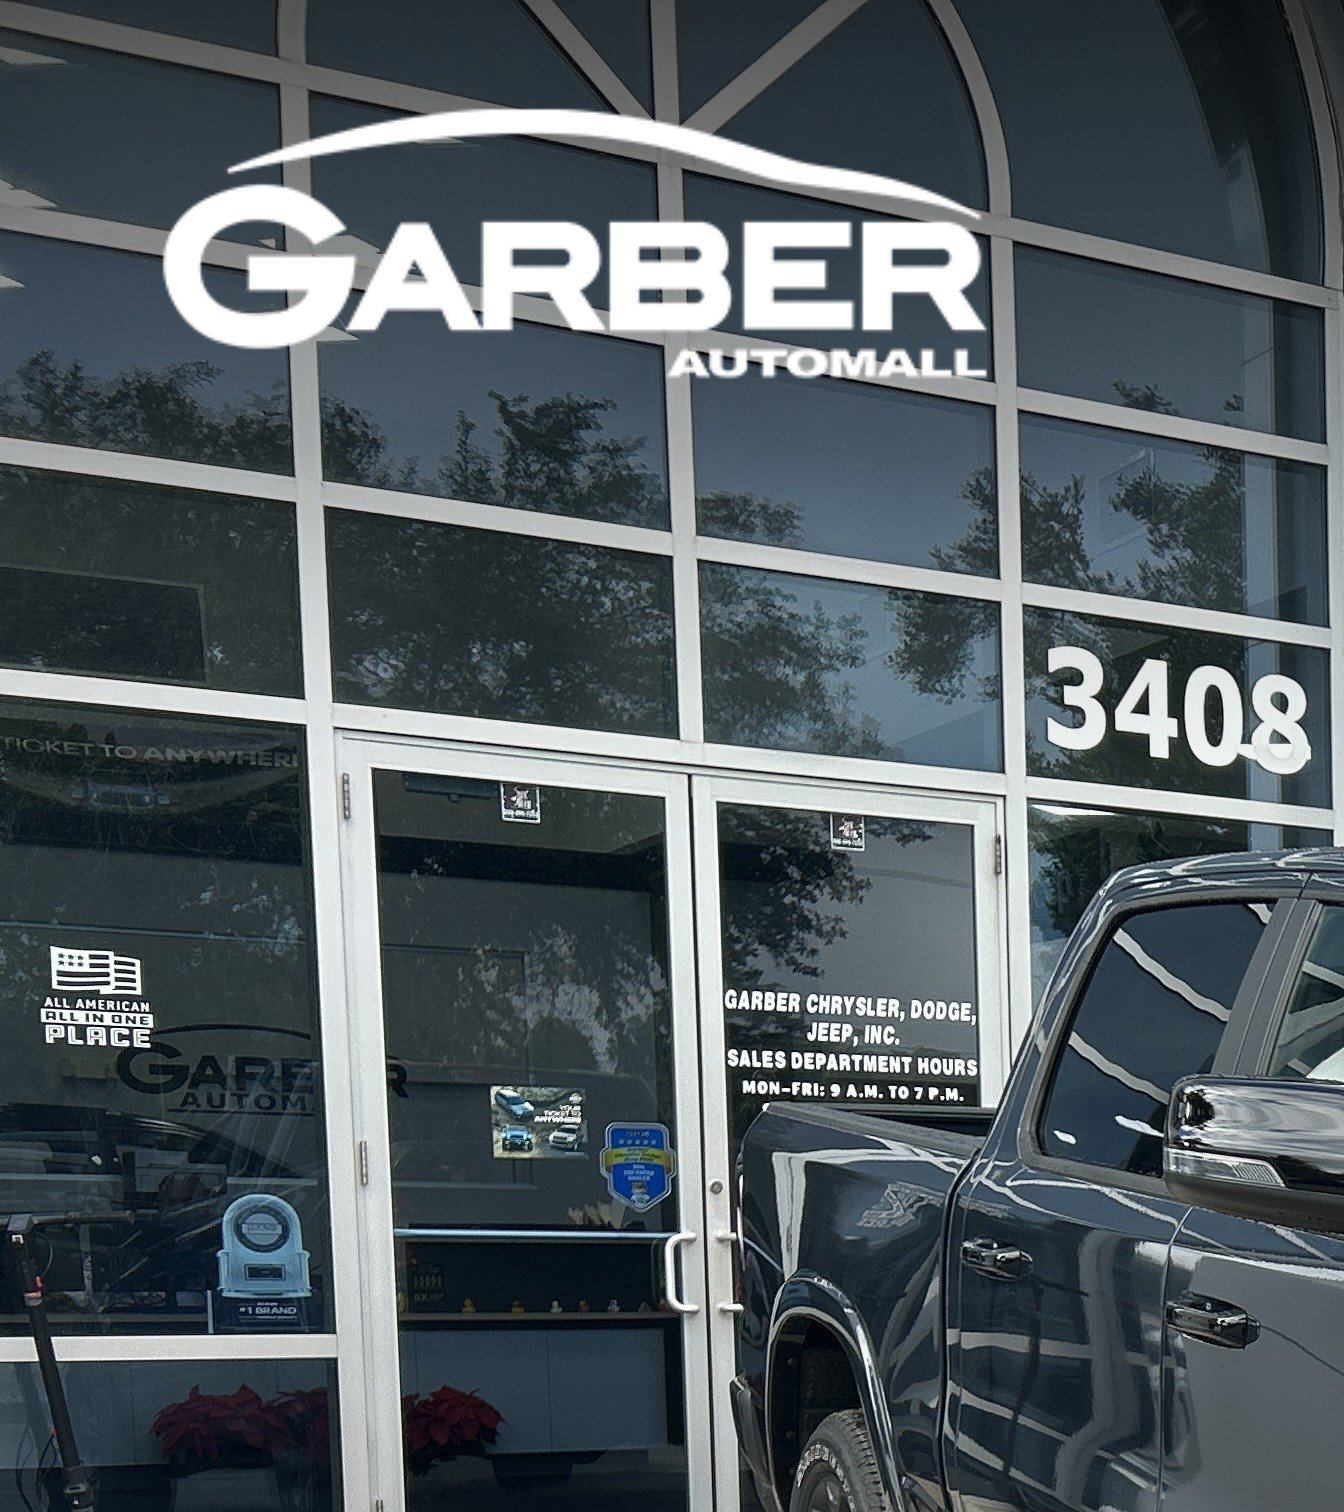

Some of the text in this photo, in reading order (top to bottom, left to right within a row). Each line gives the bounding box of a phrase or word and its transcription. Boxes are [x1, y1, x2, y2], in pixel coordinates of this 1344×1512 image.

[1046, 645, 1309, 775] 3408
[44, 996, 150, 1013] ALL AMERICAN
[724, 988, 977, 1026] GARBER CHRYSLER, DODGE,
[46, 1010, 150, 1026] ALL IN ONE
[45, 1024, 152, 1049] PLACE
[806, 1022, 900, 1047] JEEP, INC.
[727, 1049, 978, 1077] SALES DEPARTMENT HOURS
[742, 1080, 964, 1102] MON-FRI: 9 A.M. TO 7 P.M.
[255, 1306, 297, 1316] BRAND
